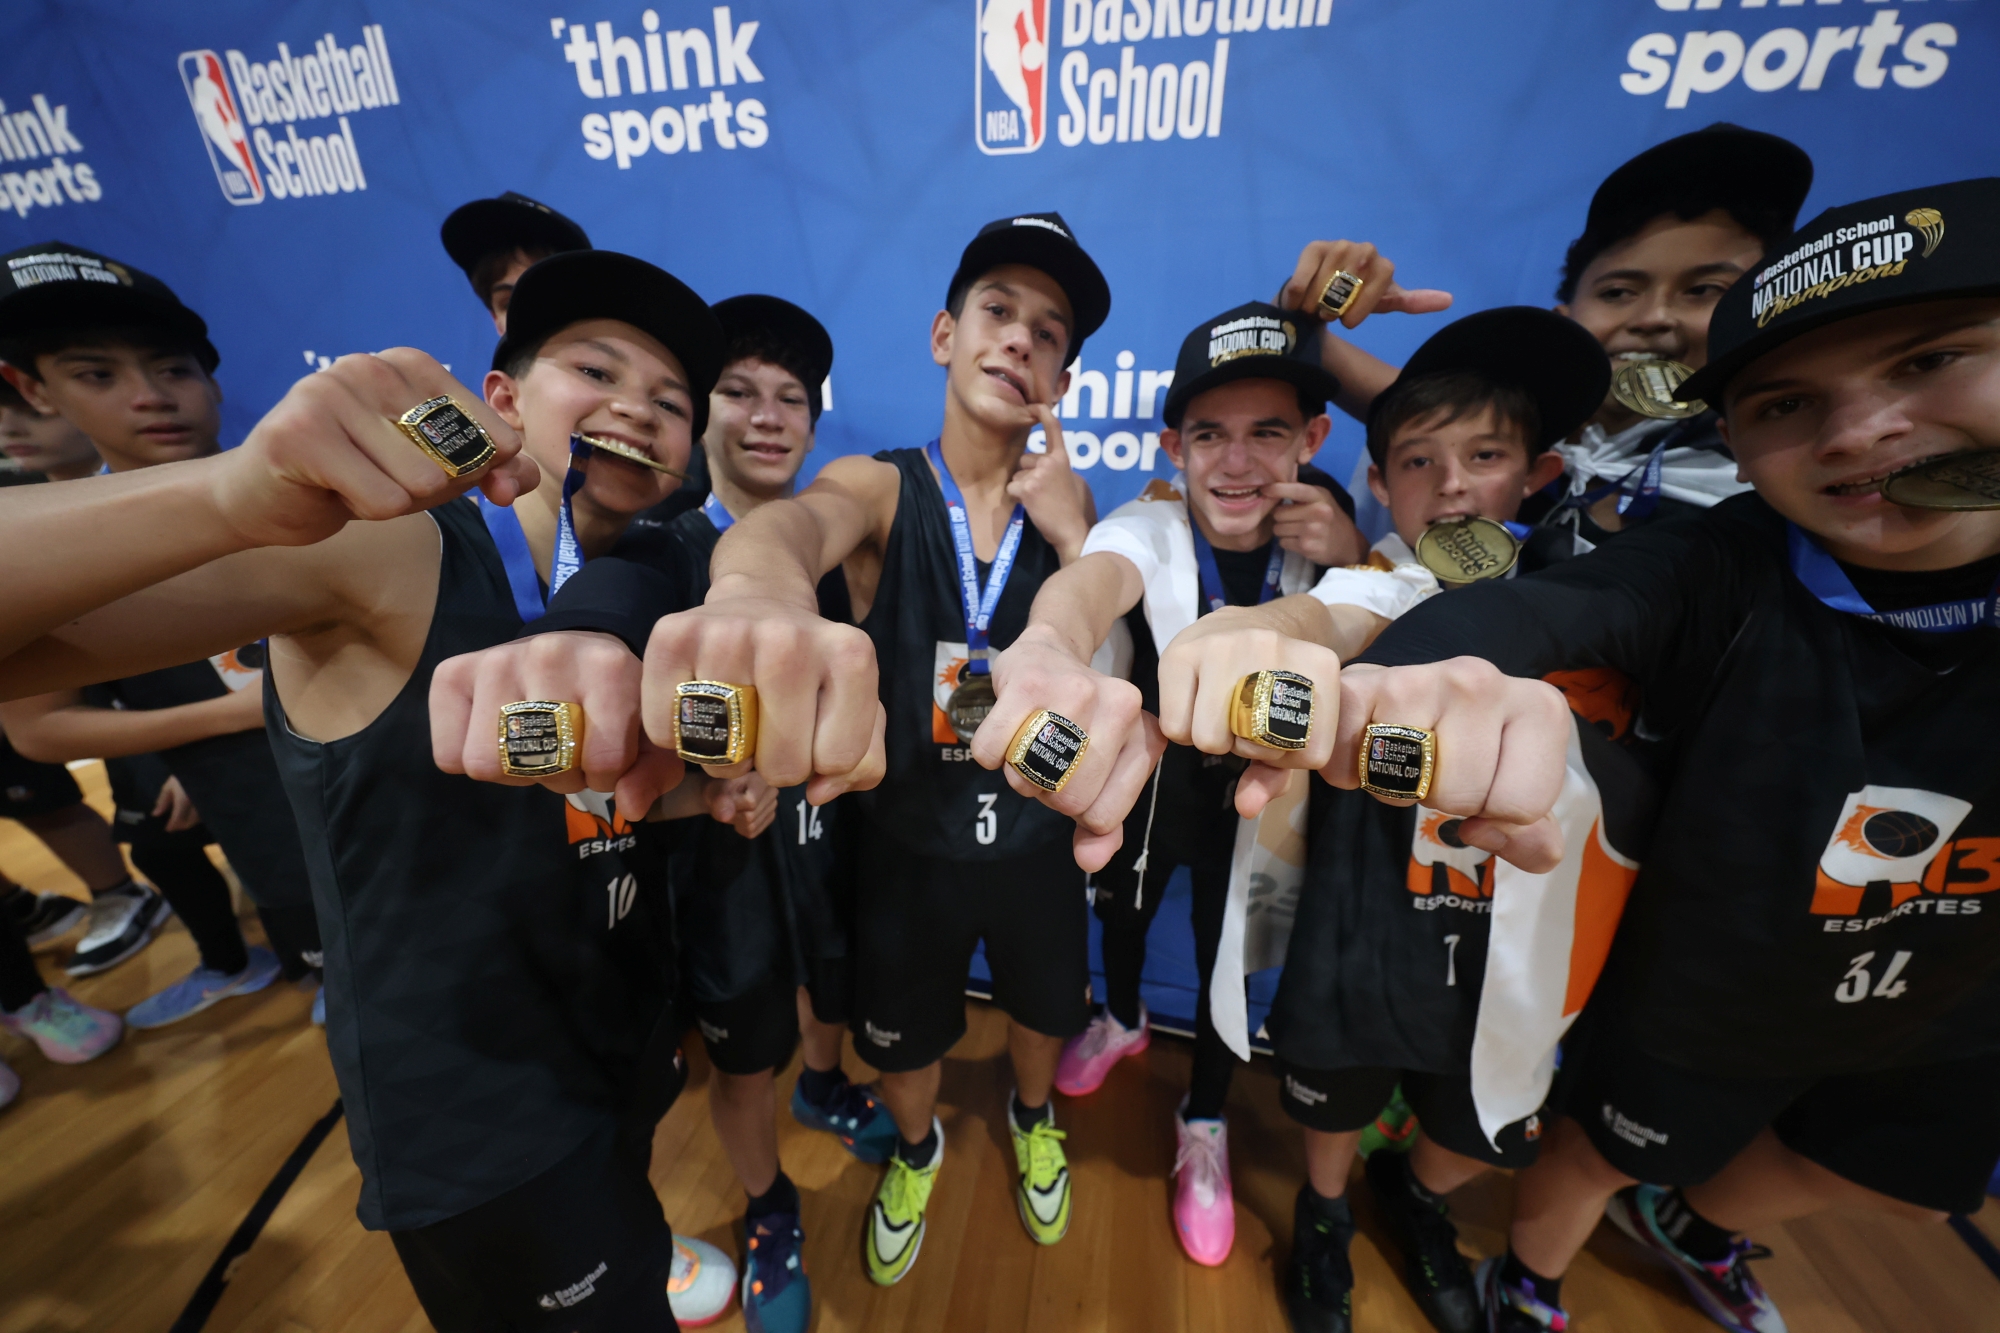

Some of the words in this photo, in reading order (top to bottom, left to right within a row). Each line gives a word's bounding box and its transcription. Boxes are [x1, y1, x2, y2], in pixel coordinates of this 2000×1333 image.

[226, 24, 400, 126] Basketball
[1619, 9, 1958, 109] sports
[1058, 38, 1230, 147] School
[581, 90, 770, 170] sports
[986, 110, 1019, 142] NBA
[253, 116, 367, 200] School
[1763, 232, 1833, 282] Basketball
[1836, 215, 1894, 245] School
[1752, 250, 1848, 319] NATIONAL
[1852, 231, 1913, 271] CUP
[1756, 259, 1908, 328] Champions
[1208, 330, 1259, 360] NATIONAL
[1260, 329, 1286, 351] CUP
[682, 685, 733, 697] CHAMPIONS
[1049, 713, 1087, 739] CHAMPIONS
[1052, 727, 1080, 751] Basketball
[1264, 735, 1292, 748] NATIONAL
[1372, 727, 1425, 740] CHAMPIONS
[1030, 741, 1057, 766] NATIONAL
[1055, 758, 1070, 771] CUP
[1047, 739, 1067, 753] School
[1384, 751, 1408, 762] School
[1385, 740, 1420, 755] Basketball
[1017, 763, 1043, 785] NATIONAL
[1043, 781, 1056, 790] CUP
[1369, 760, 1403, 777] NATIONAL
[1405, 766, 1419, 778] CUP
[976, 793, 998, 845] 3
[607, 872, 637, 930] 10
[1823, 899, 1981, 932] ESPORTES
[1834, 950, 1913, 1004] 34
